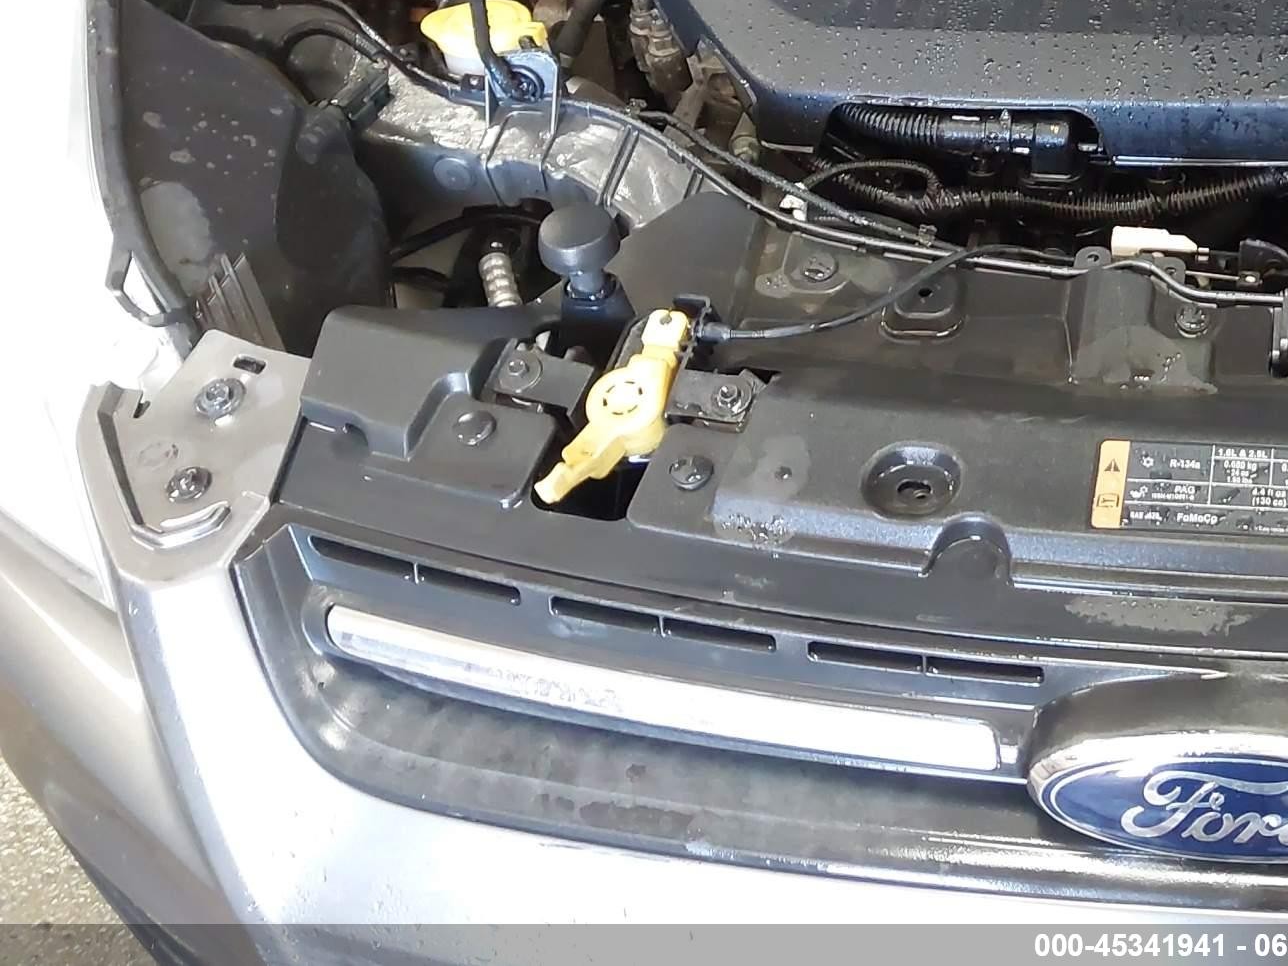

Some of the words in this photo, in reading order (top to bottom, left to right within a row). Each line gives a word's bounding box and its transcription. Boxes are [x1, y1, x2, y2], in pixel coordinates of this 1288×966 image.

[1169, 458, 1201, 470] R-134a
[1247, 461, 1258, 471] kg
[1174, 485, 1195, 495] PAG
[1251, 497, 1271, 507] (130
[1177, 512, 1218, 524] FoMoCo
